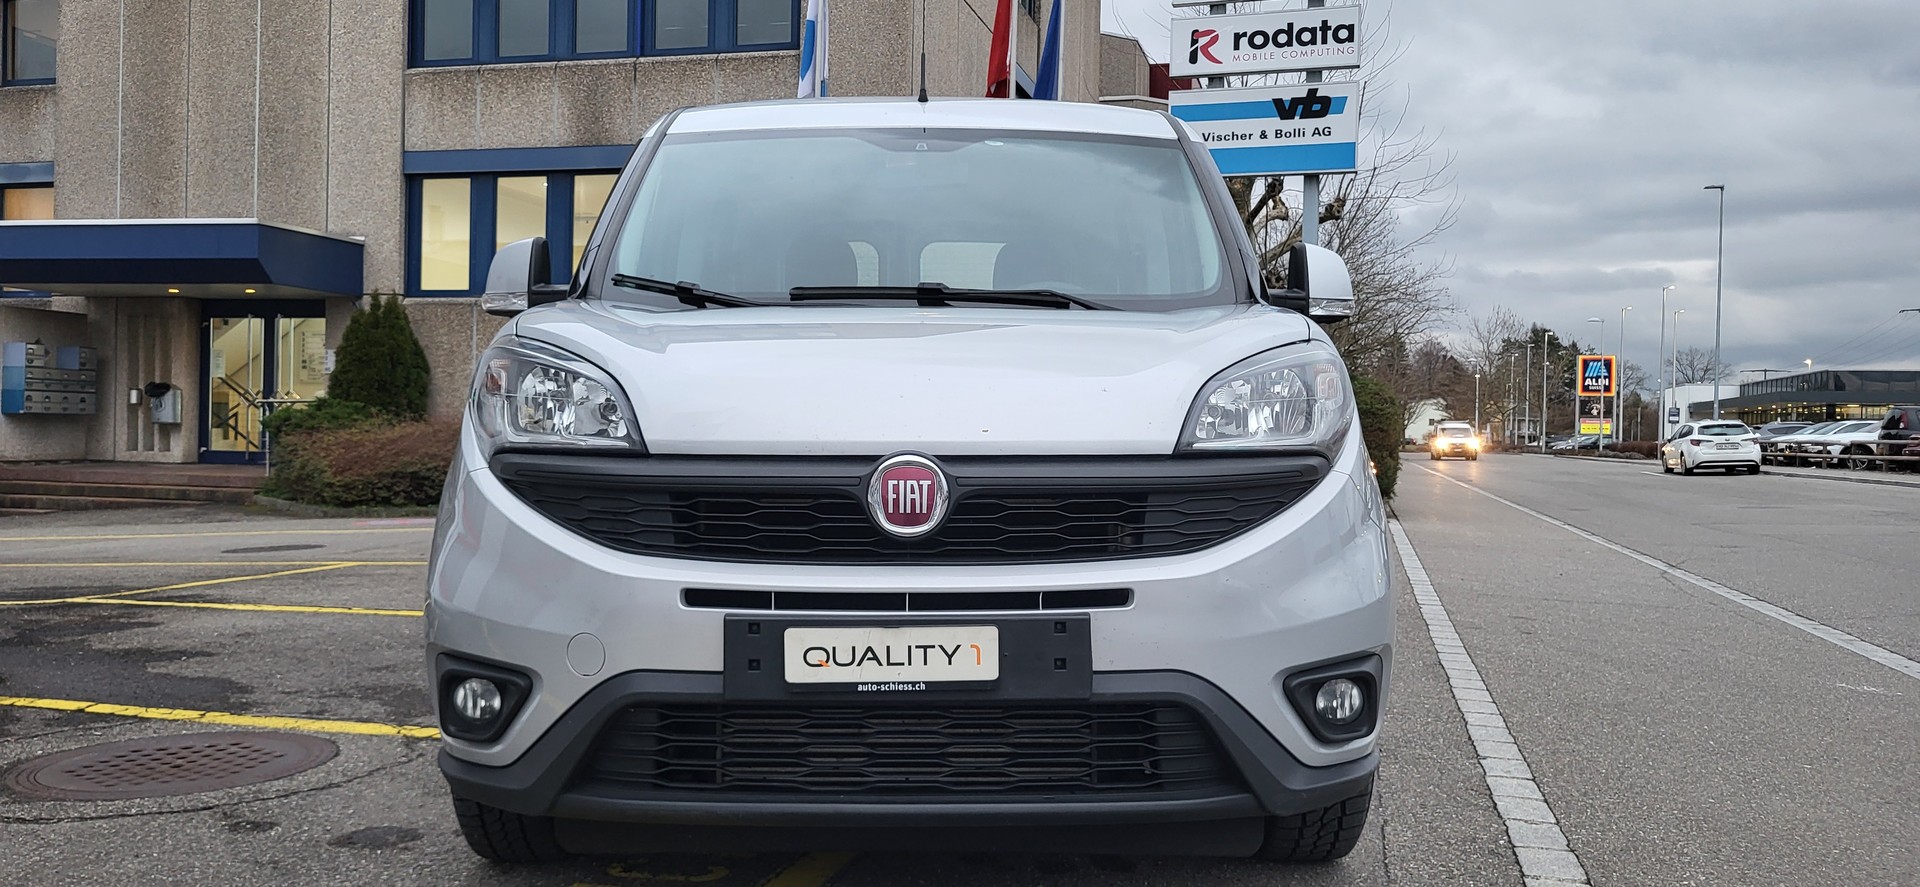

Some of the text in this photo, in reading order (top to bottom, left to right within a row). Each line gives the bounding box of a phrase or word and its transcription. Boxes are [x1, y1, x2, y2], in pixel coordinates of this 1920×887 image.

[1233, 20, 1355, 51] rodata
[1232, 46, 1355, 62] MOBILE COMPUTING
[1271, 88, 1332, 120] vb
[1202, 126, 1332, 142] Vischer & Bolli AG
[1584, 378, 1609, 386] ALDI
[887, 480, 932, 514] FIAT
[857, 682, 926, 692] auto-schiess.ch
